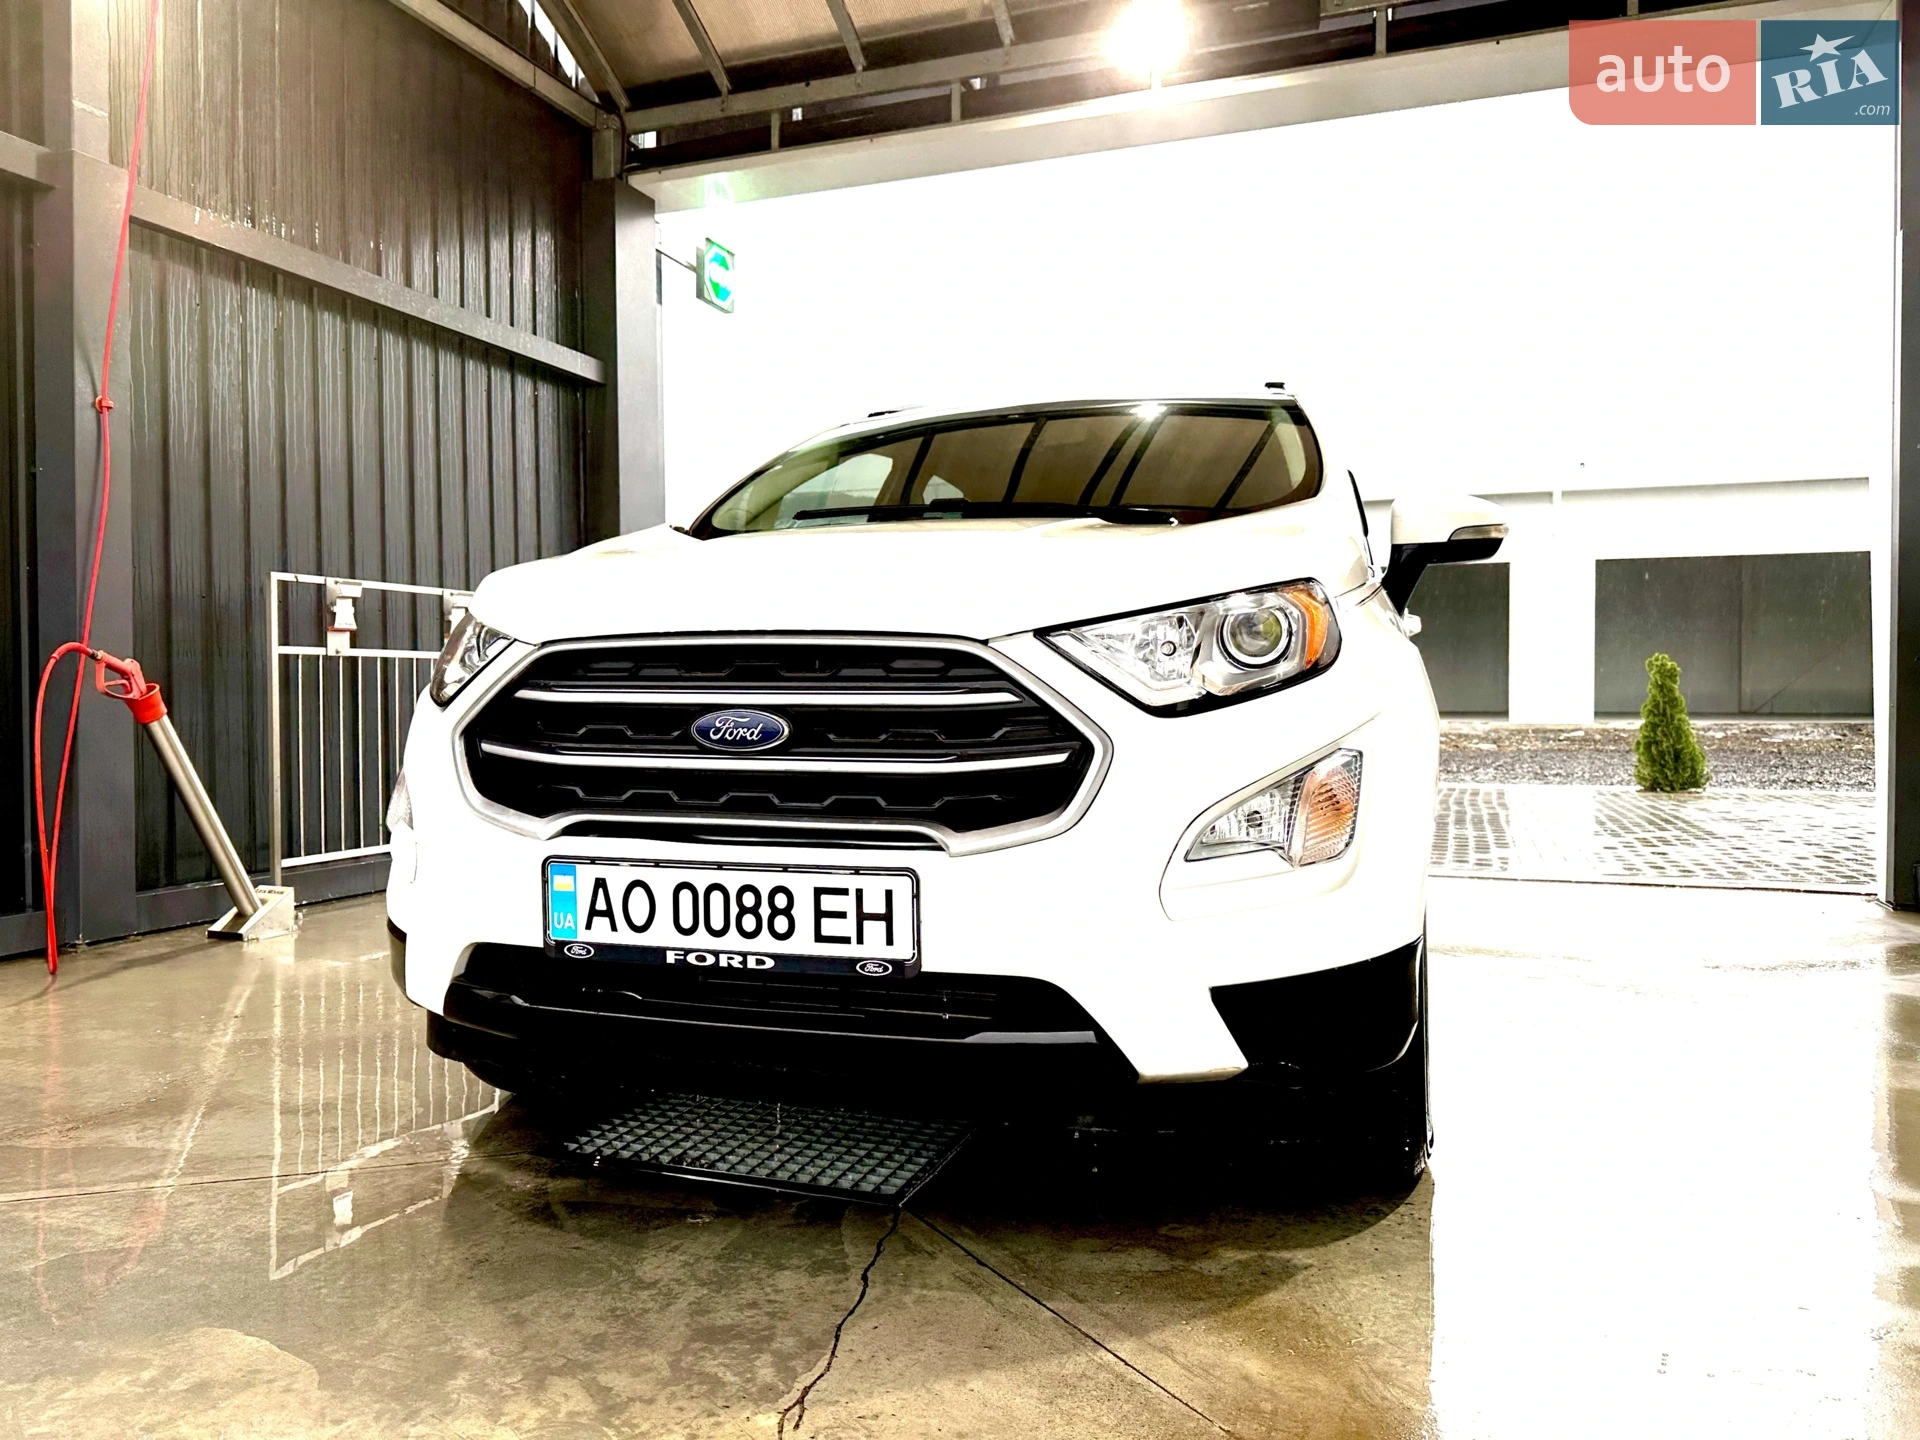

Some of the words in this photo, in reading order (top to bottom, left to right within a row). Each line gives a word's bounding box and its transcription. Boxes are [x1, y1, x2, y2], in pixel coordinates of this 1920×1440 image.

[709, 716, 763, 740] Ford
[553, 911, 576, 931] UA
[585, 877, 656, 934] AO
[672, 881, 796, 941] 0088
[813, 886, 894, 946] EH
[665, 950, 776, 970] FORD
